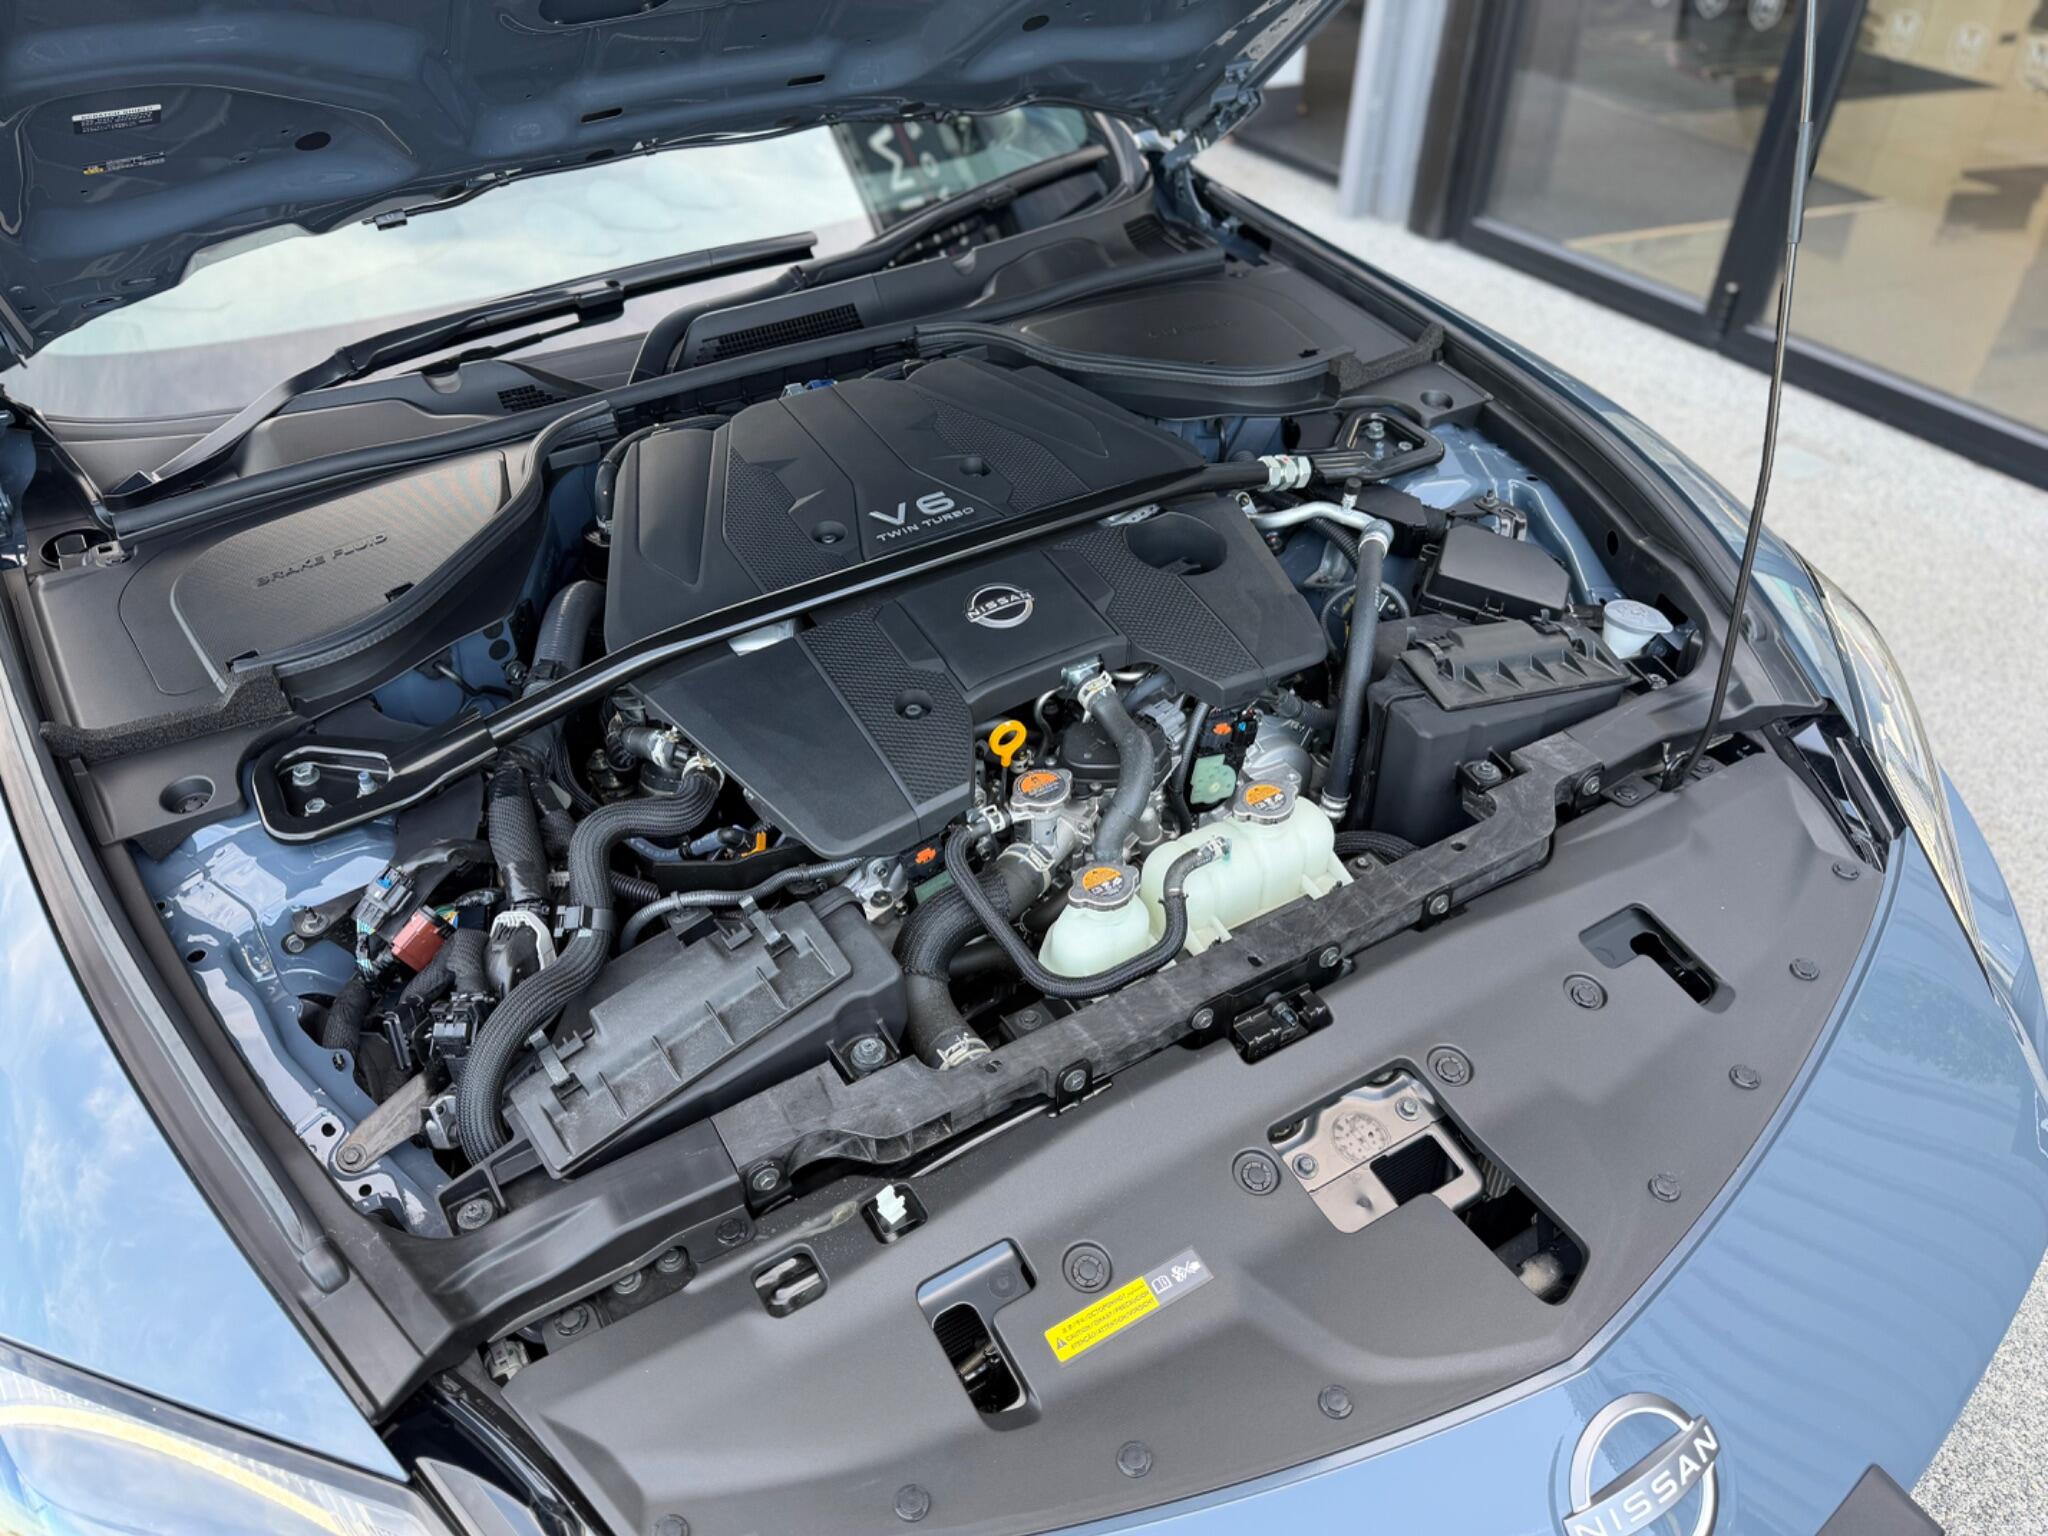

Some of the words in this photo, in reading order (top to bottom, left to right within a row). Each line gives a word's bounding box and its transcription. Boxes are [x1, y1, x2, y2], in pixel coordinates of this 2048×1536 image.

[876, 523, 919, 541] TWIN
[922, 507, 975, 527] TURBO
[257, 554, 326, 587] BRAKE
[333, 534, 388, 559] FLUID
[967, 591, 1034, 619] NISSAN
[1573, 1425, 1718, 1536] NISSAN
